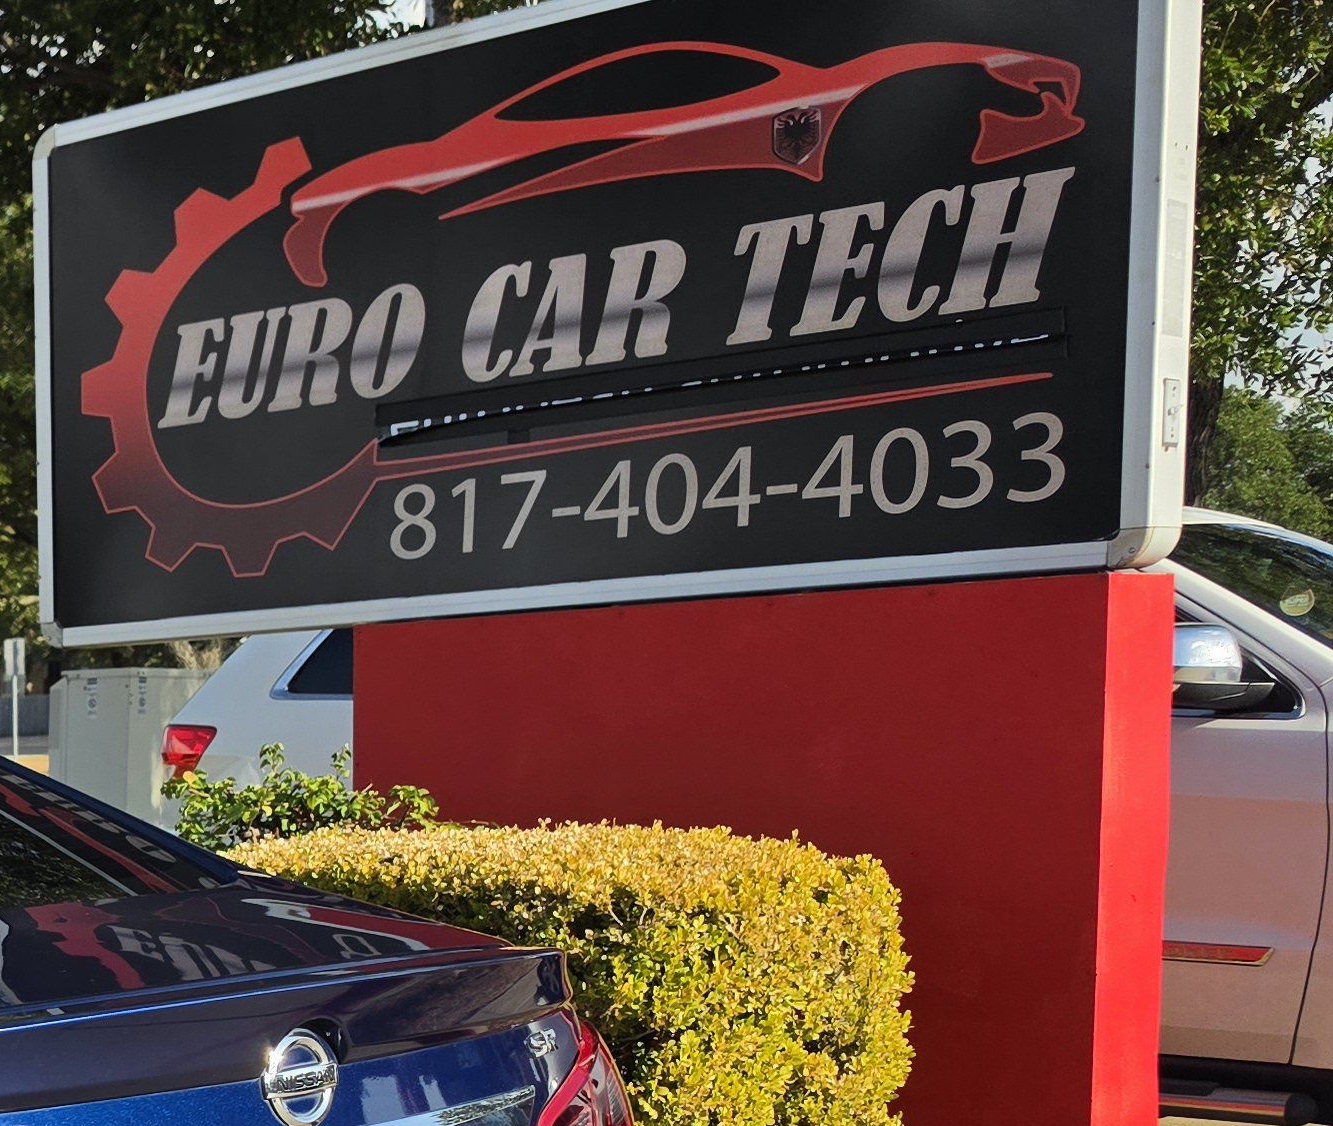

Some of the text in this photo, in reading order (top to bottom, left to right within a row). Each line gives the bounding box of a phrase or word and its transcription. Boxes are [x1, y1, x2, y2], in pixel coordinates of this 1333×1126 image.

[157, 283, 426, 430] EURO
[461, 239, 687, 384] CAR
[725, 166, 1075, 348] TECH
[389, 411, 1068, 562] 817-404-4033
[276, 1063, 335, 1092] NISSAN
